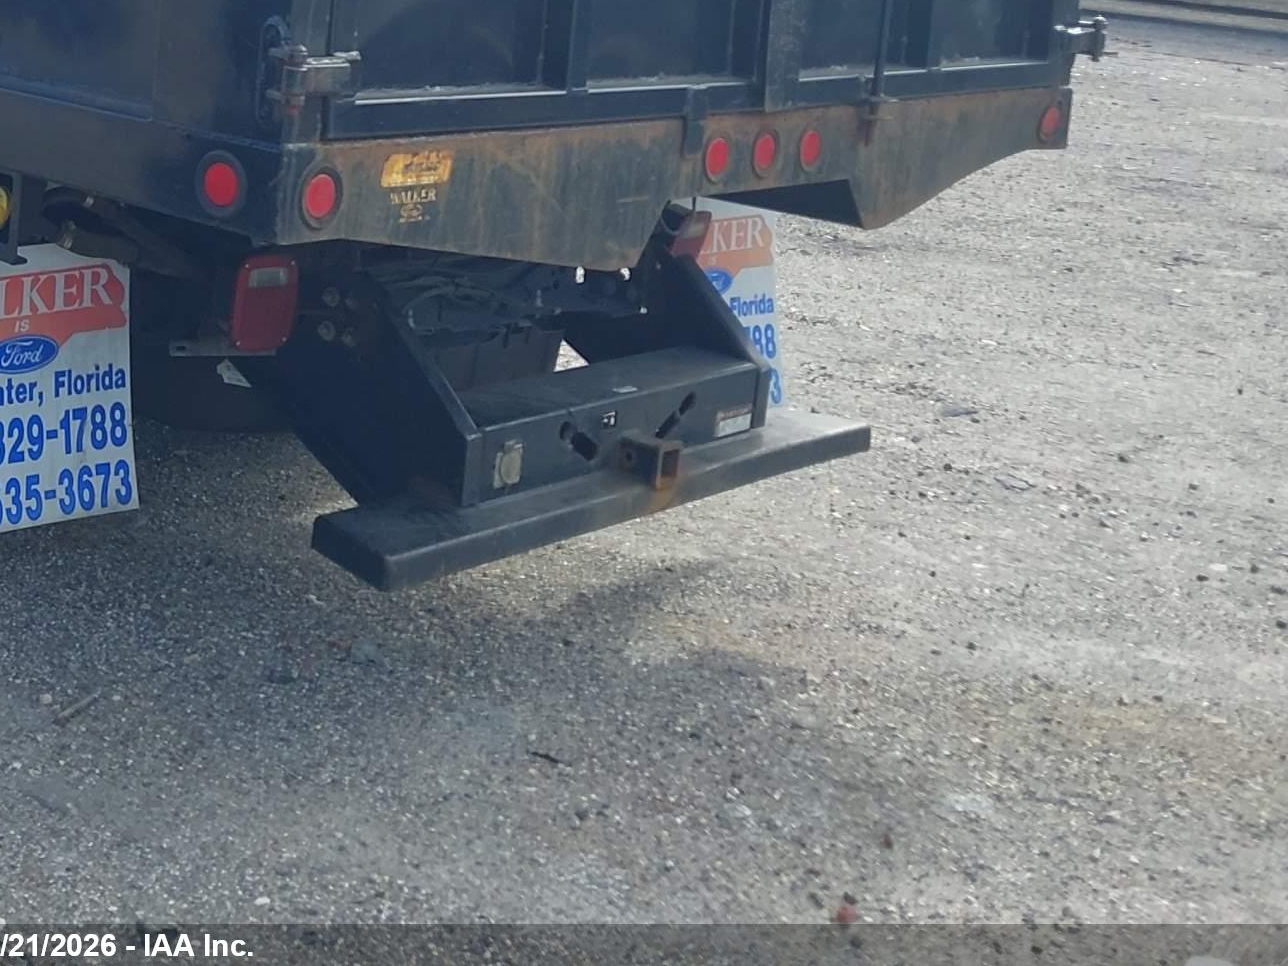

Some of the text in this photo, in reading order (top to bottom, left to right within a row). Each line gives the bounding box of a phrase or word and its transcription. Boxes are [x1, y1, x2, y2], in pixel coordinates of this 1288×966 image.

[15, 318, 30, 333] IS
[0, 339, 44, 368] Ford
[54, 363, 126, 397] Florida
